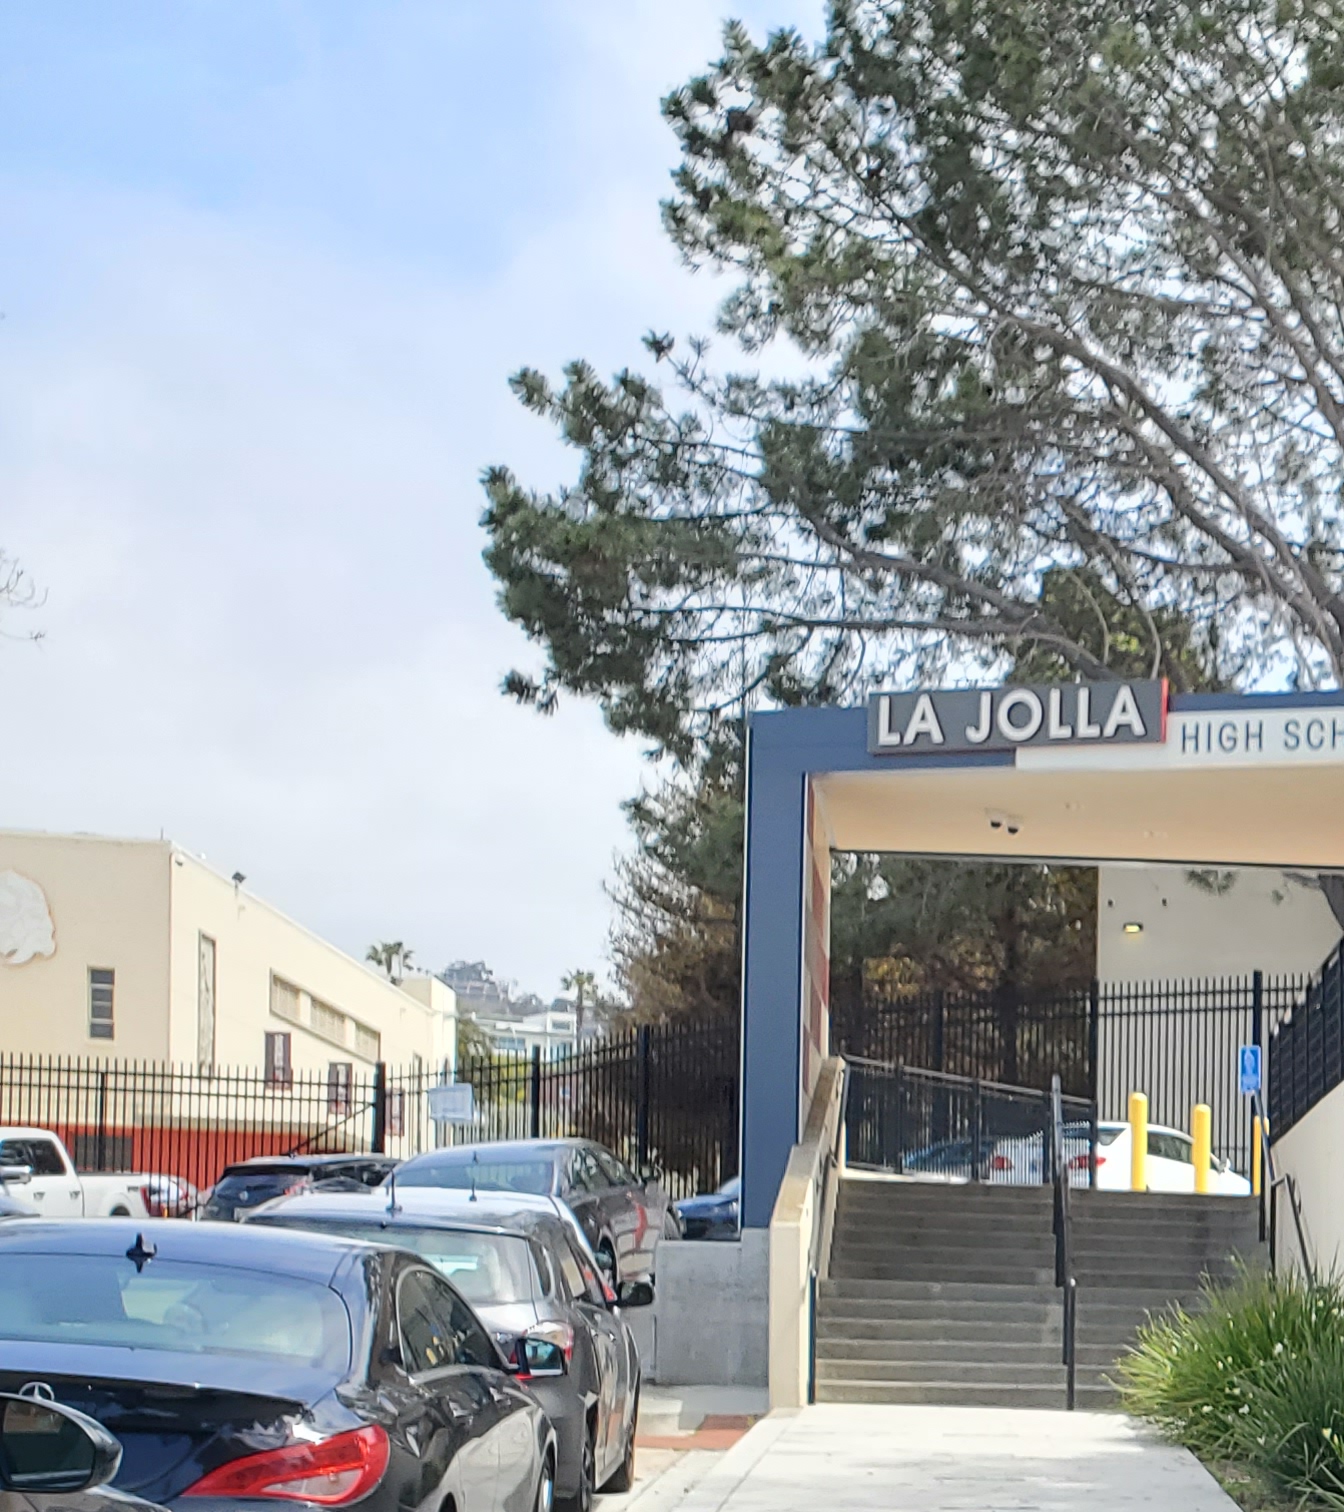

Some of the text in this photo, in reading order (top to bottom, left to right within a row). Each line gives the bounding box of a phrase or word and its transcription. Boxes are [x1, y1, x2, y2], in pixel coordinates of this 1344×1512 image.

[878, 684, 1147, 747] LA JOLLA
[1181, 719, 1264, 754] HIGH
